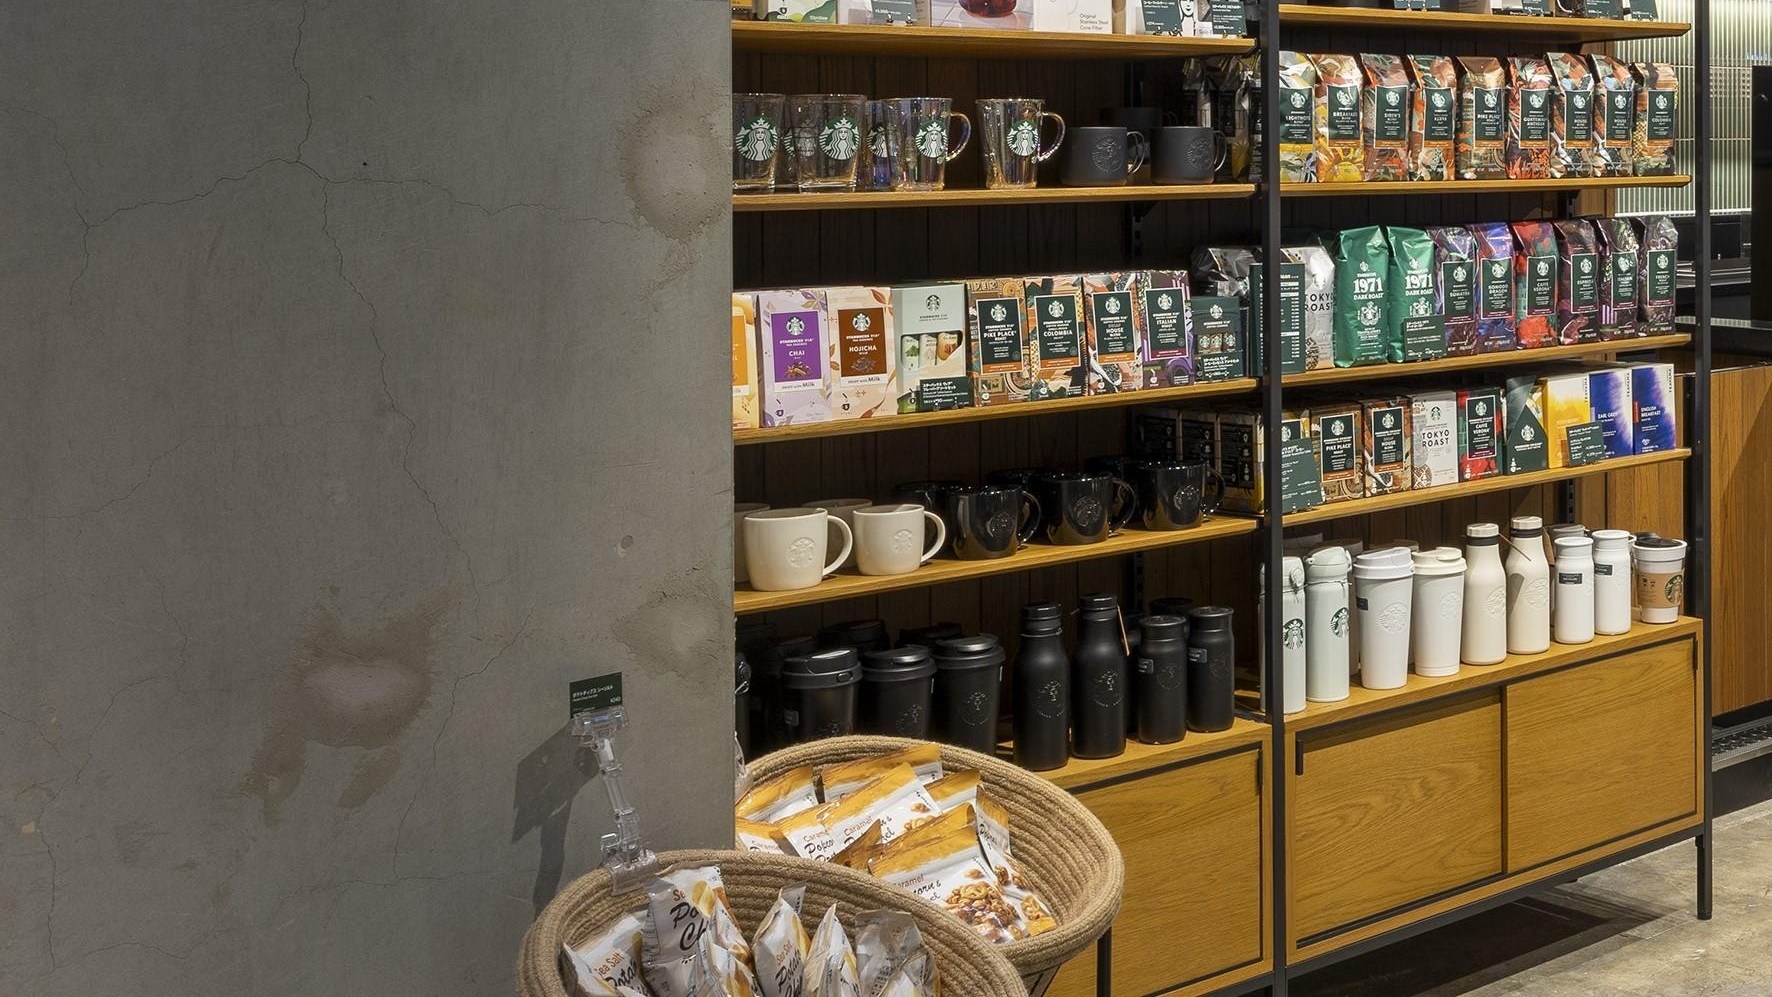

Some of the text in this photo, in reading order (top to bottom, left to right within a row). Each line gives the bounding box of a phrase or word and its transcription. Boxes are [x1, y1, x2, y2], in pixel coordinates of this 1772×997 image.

[1080, 13, 1096, 21] Original
[1352, 278, 1383, 294] 1971
[1405, 275, 1434, 290] 1971
[1354, 292, 1384, 301] DARK ROAST
[849, 345, 877, 353] HOJICHA
[1421, 429, 1450, 439] TOKYO
[1422, 439, 1450, 448] ROAST
[844, 815, 872, 837] Caramel
[804, 838, 835, 860] Popco
[672, 889, 686, 902] Se
[913, 882, 934, 896] corn
[610, 952, 625, 967] Salt
